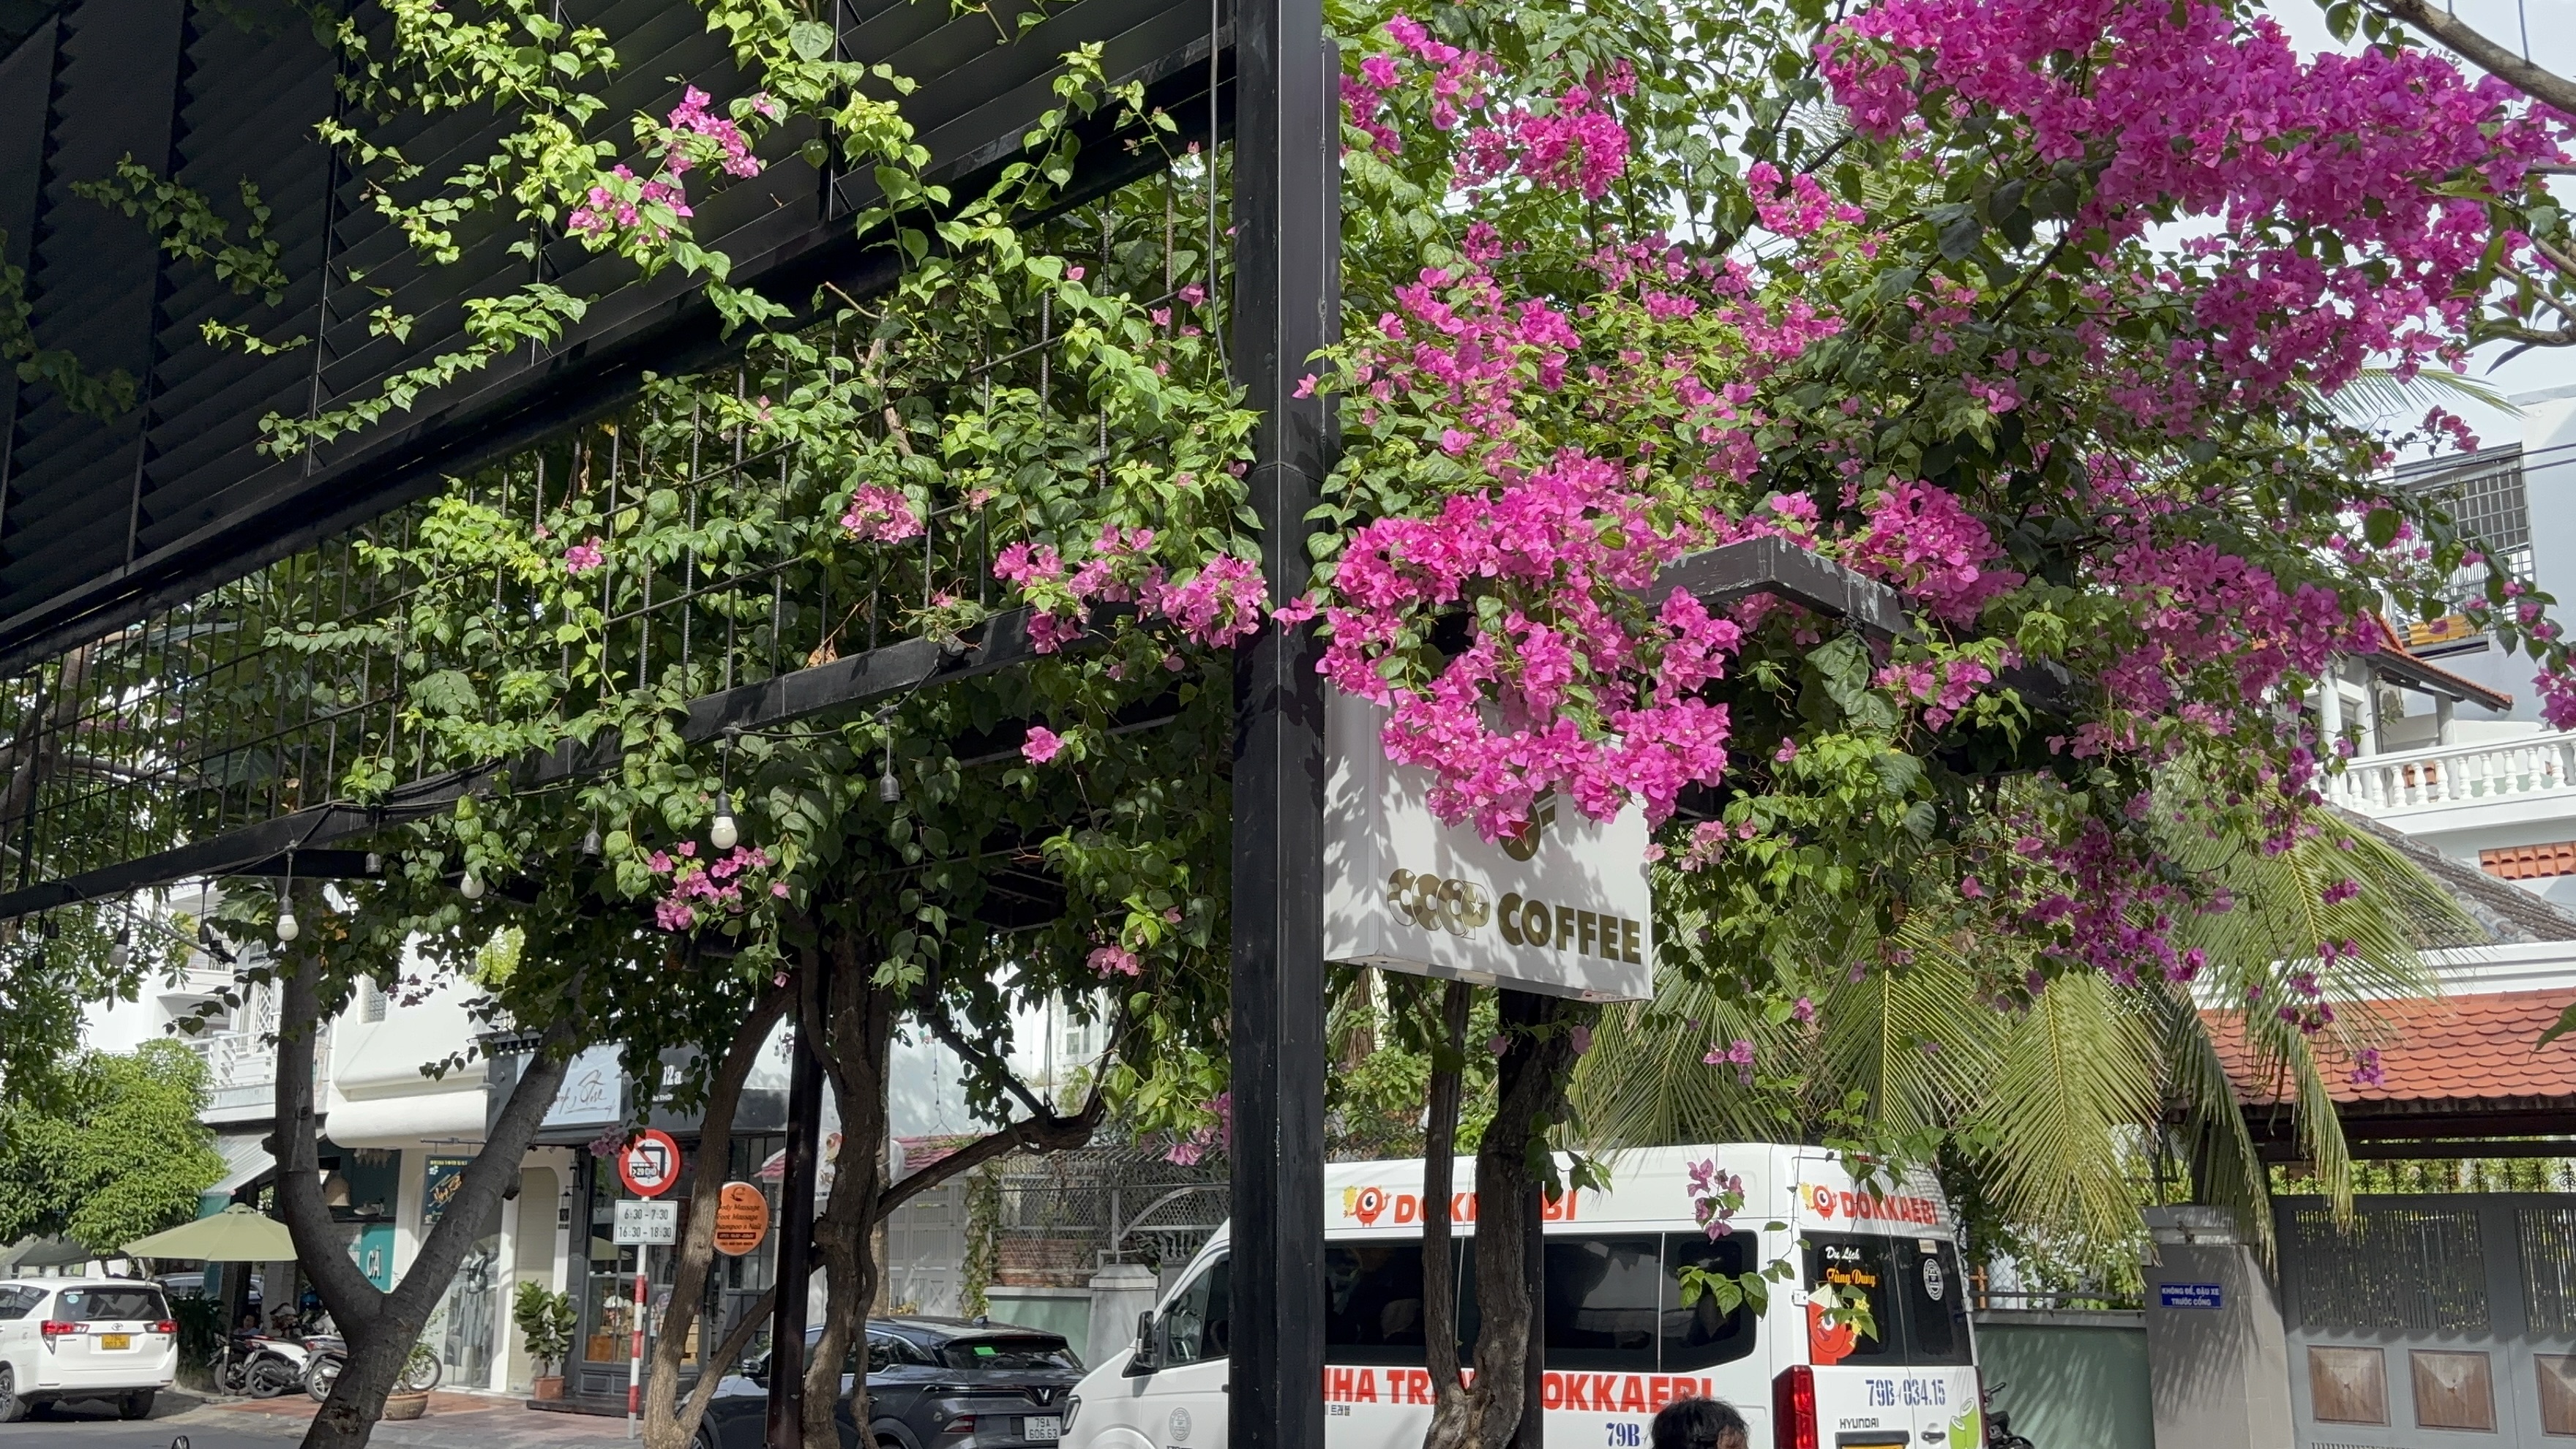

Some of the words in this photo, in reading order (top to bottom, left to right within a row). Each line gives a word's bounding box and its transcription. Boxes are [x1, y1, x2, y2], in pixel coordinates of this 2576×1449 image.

[1497, 892, 1641, 965] COFFEE
[1839, 1191, 1939, 1226] DOKKAEBI
[624, 1209, 643, 1220] 6:30
[651, 1209, 669, 1220] 7:30
[619, 1227, 641, 1238] 16:30
[651, 1227, 672, 1238] 18:30
[1825, 1246, 1841, 1260] Du
[2162, 1287, 2184, 1295] KHÔNG
[2171, 1297, 2193, 1306] TRƯỚC
[1543, 1373, 1712, 1413] OKKAEBI
[1034, 1418, 1051, 1428] 79A
[1839, 1418, 1879, 1429] HYUNDAI
[1029, 1429, 1057, 1439] 606.63
